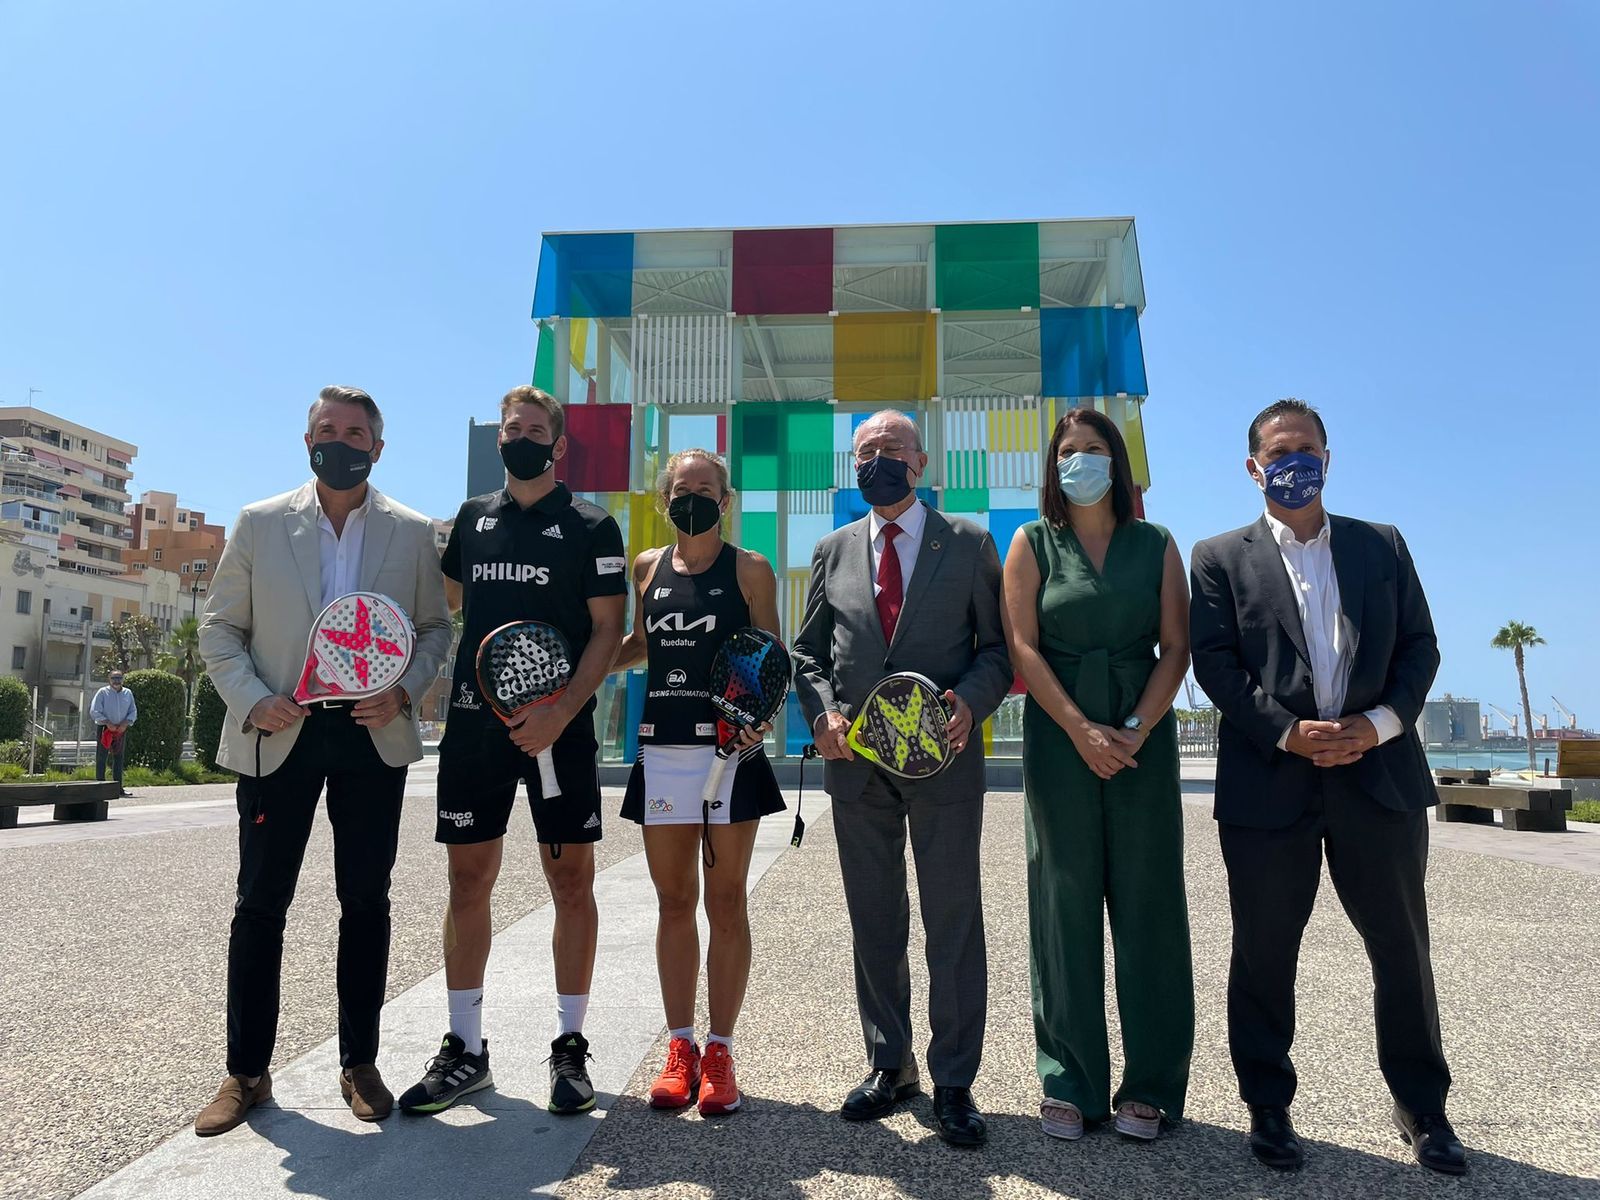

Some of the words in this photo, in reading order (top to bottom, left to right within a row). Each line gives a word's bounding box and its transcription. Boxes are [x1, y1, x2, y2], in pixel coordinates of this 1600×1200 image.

[472, 562, 550, 585] PHILIPS
[660, 638, 697, 647] Ruedatur
[496, 659, 571, 700] adidas
[711, 694, 756, 723] starvie
[439, 810, 473, 821] GLUCO
[454, 818, 475, 828] UP!
